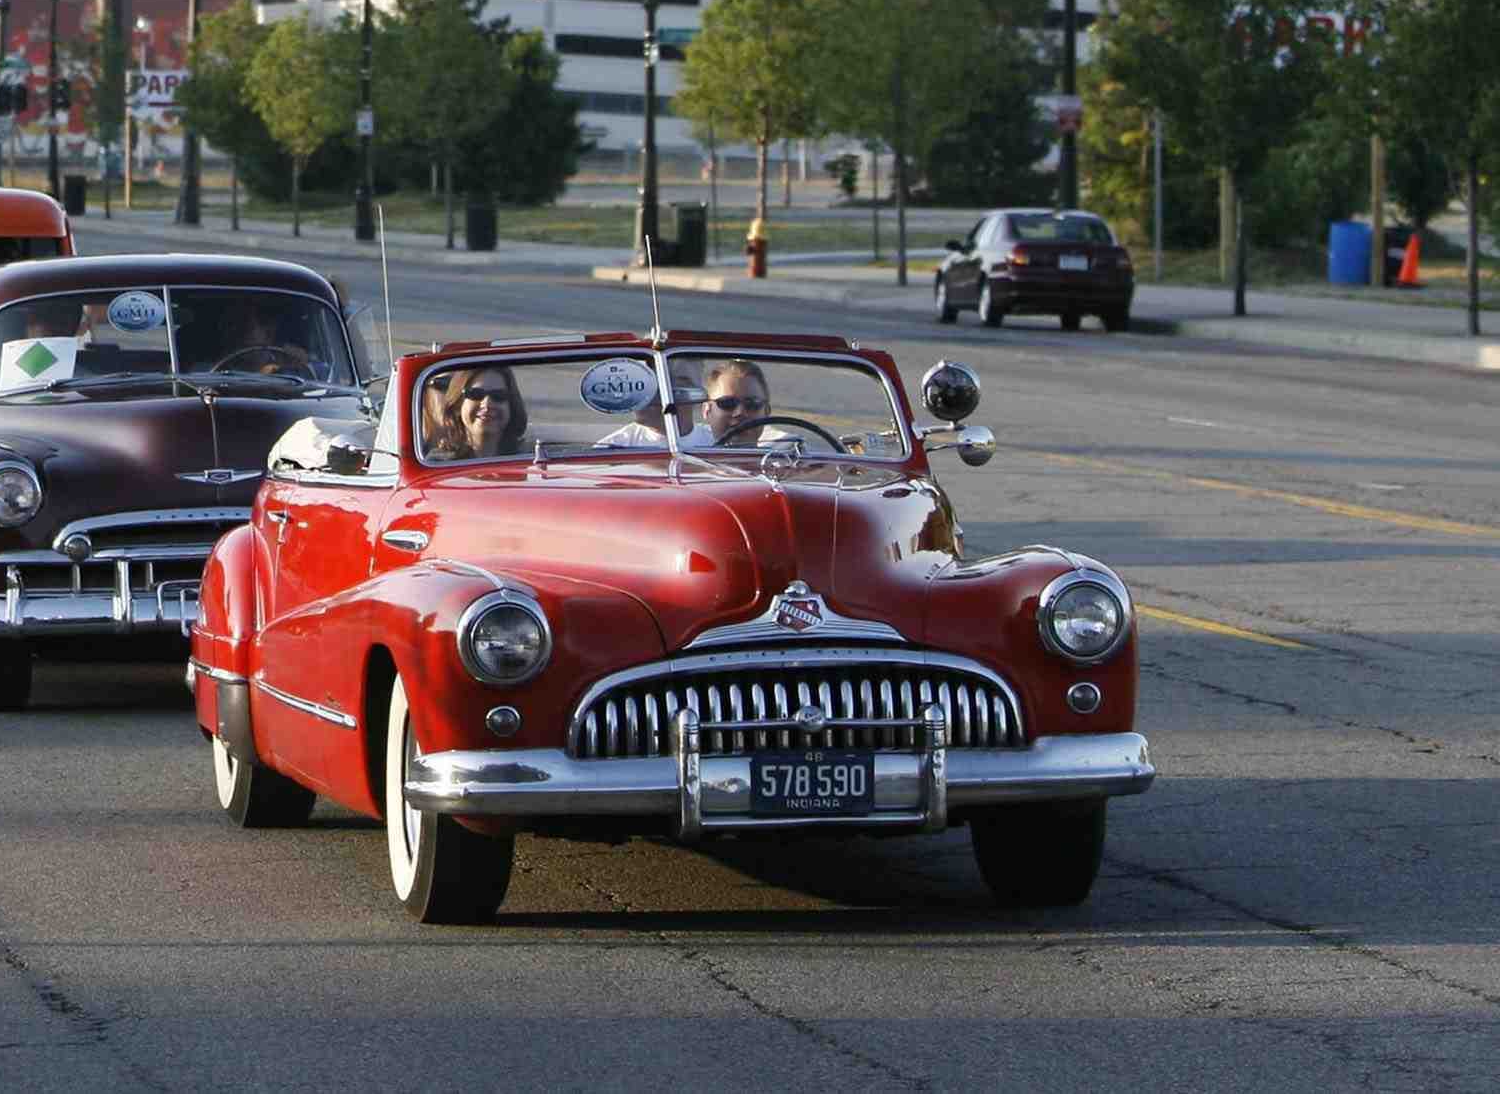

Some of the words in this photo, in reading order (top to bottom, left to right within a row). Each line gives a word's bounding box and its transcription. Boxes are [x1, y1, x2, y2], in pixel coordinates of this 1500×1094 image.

[761, 765, 810, 797] 578
[816, 765, 866, 797] 590
[786, 798, 840, 809] INDIANA
